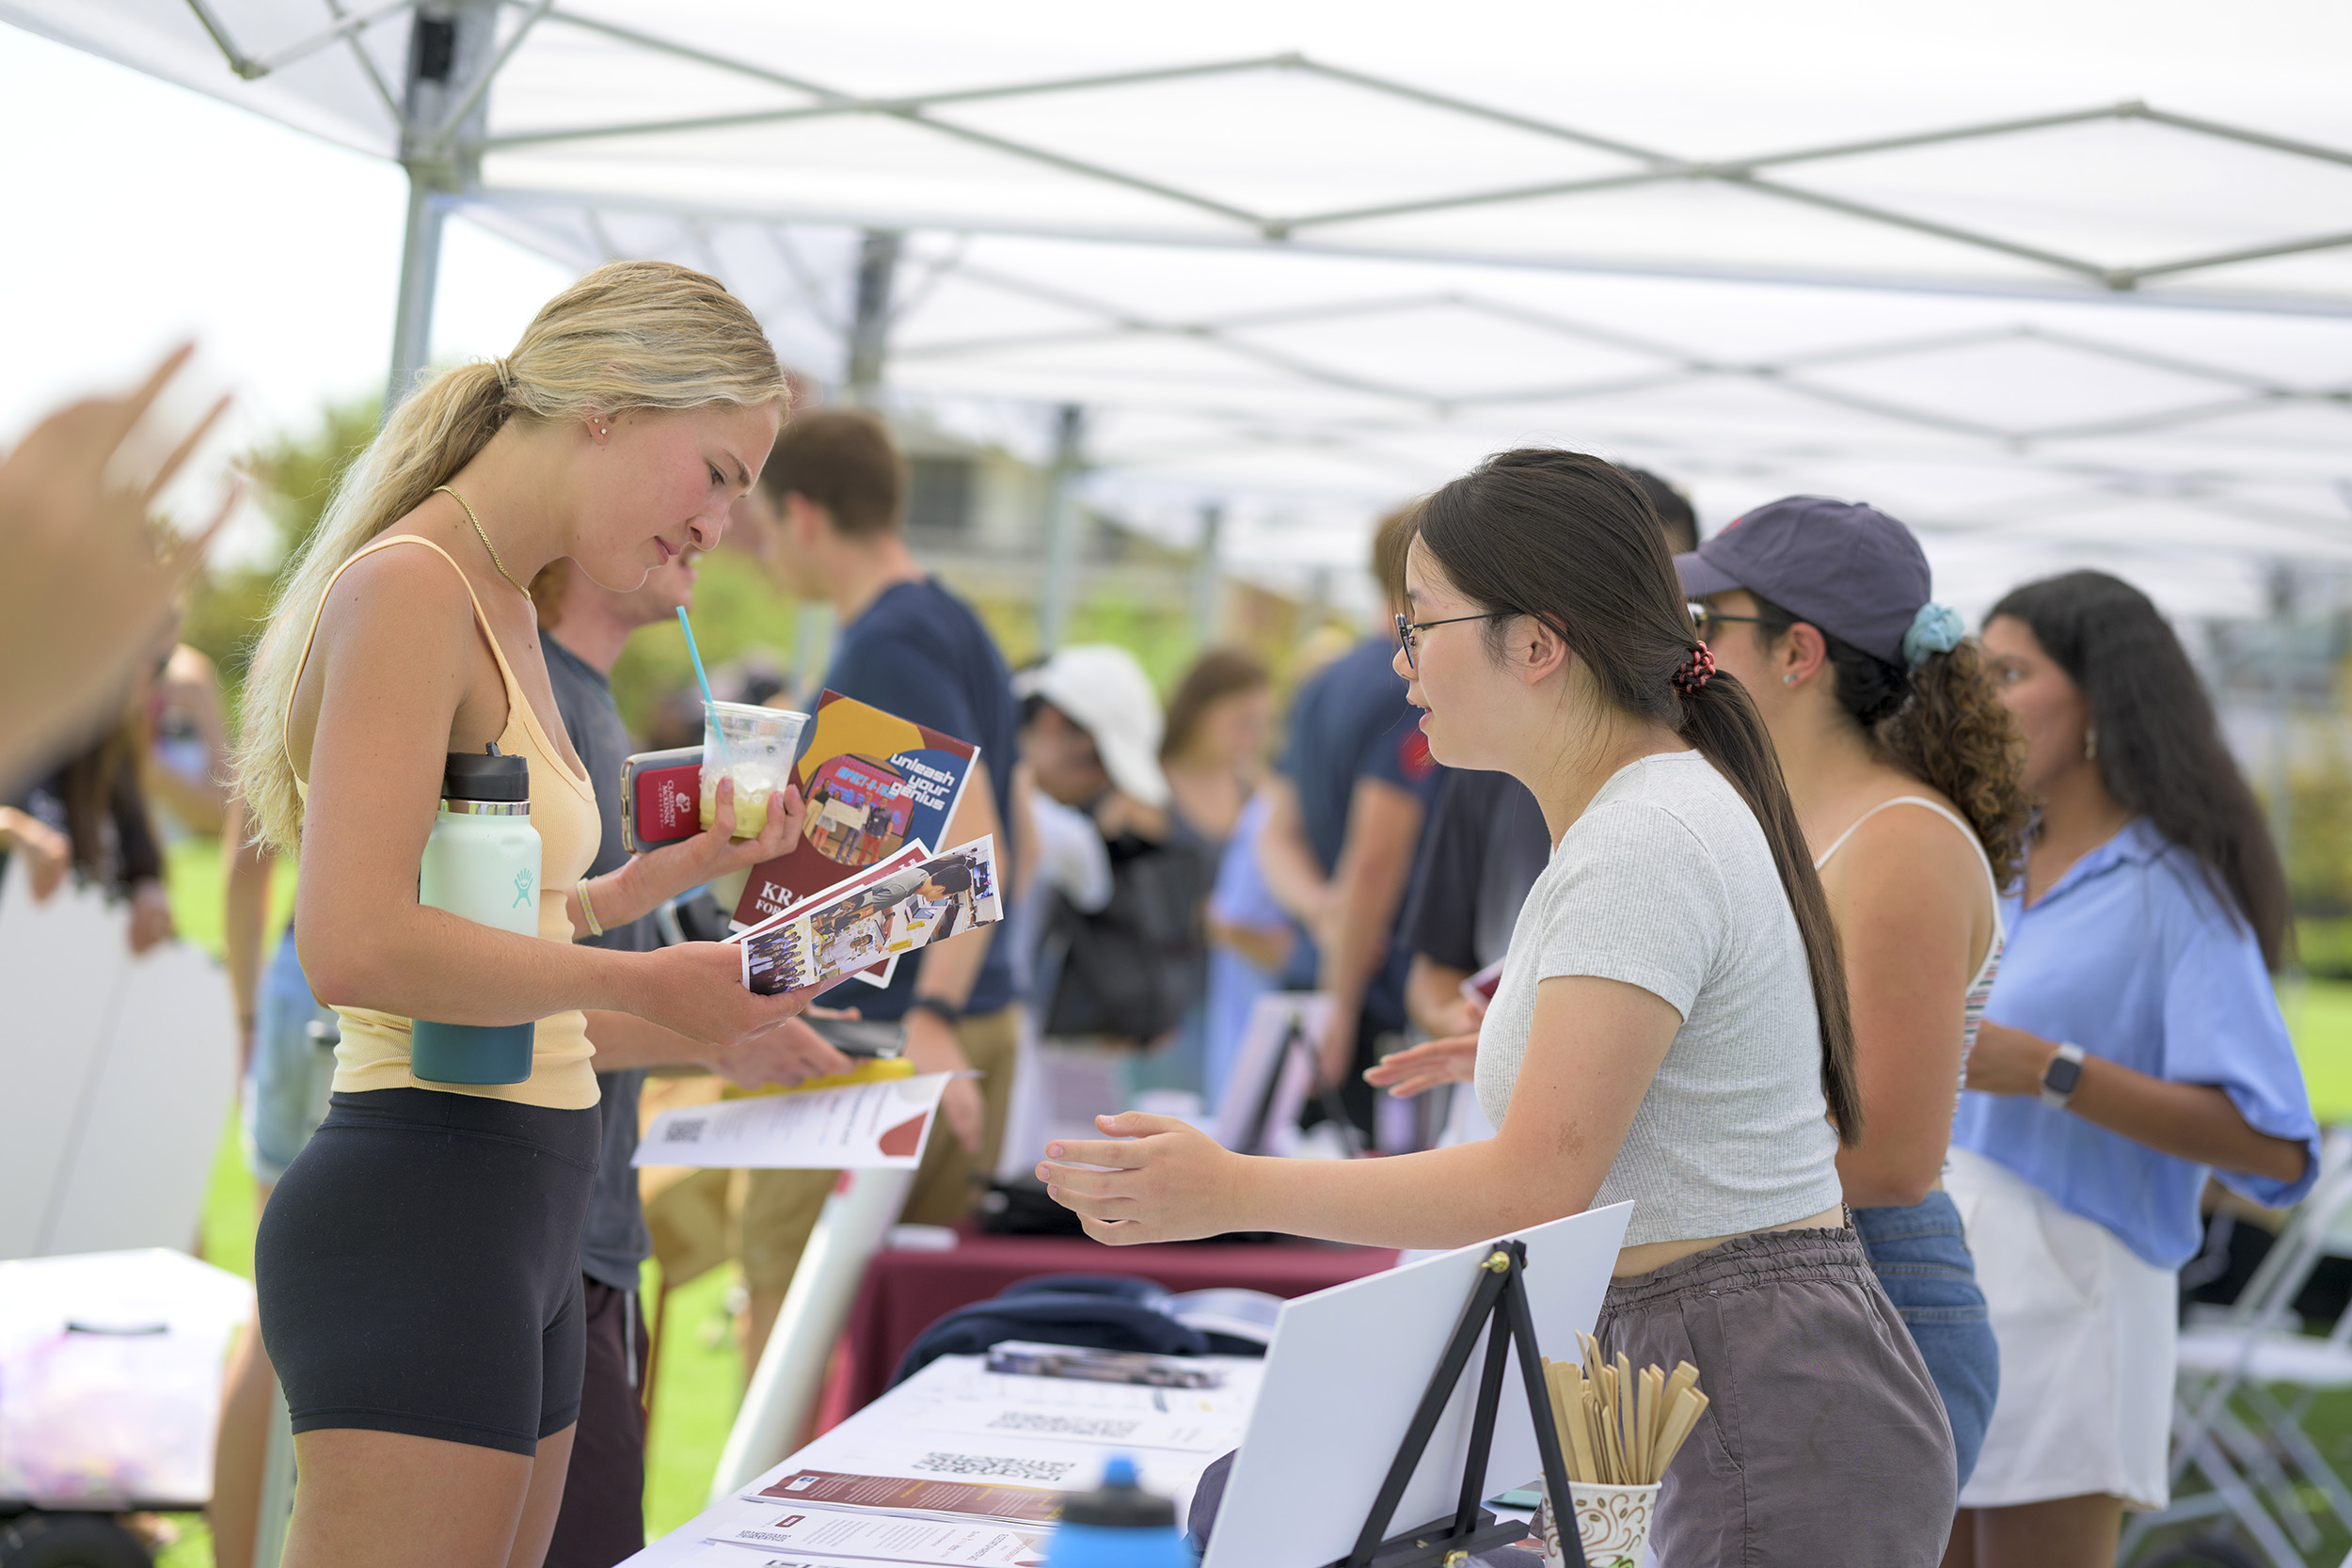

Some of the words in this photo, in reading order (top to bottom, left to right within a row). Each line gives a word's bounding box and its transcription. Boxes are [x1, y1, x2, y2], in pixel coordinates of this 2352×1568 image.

[890, 753, 955, 786] unleash
[888, 781, 946, 811] genius
[906, 774, 950, 797] your
[667, 780, 675, 828] CLAREMONT
